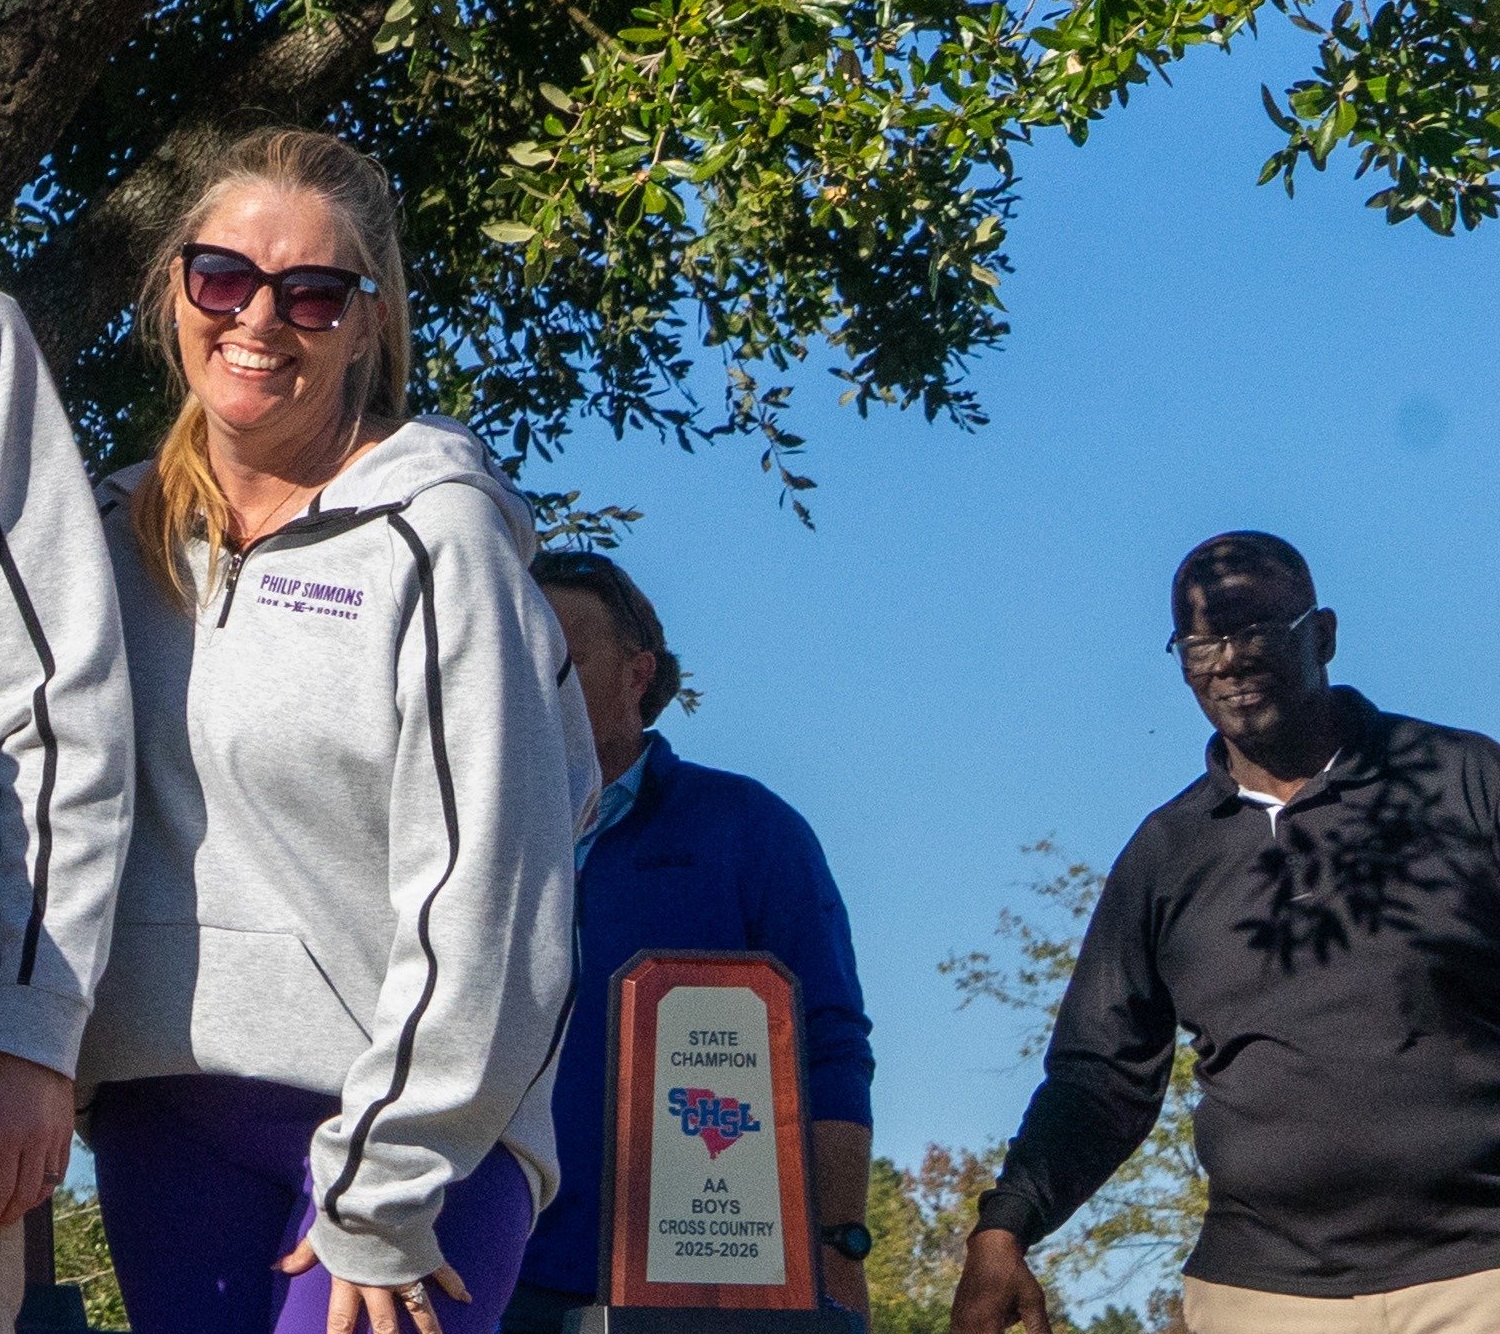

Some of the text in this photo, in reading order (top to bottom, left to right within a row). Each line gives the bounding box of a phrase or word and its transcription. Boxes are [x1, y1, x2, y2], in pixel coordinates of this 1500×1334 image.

[260, 574, 364, 606] PHILIP SIMMONS
[257, 596, 279, 606] IRON
[316, 607, 358, 620] HORSES
[688, 1030, 738, 1047] STATE
[670, 1051, 757, 1068] CHAMPION
[668, 1087, 760, 1138] SCHSL
[703, 1178, 728, 1193] AA
[691, 1199, 741, 1215] BOYS
[659, 1219, 774, 1237] CROSS COUNTRY
[674, 1241, 759, 1258] 2025-2026
